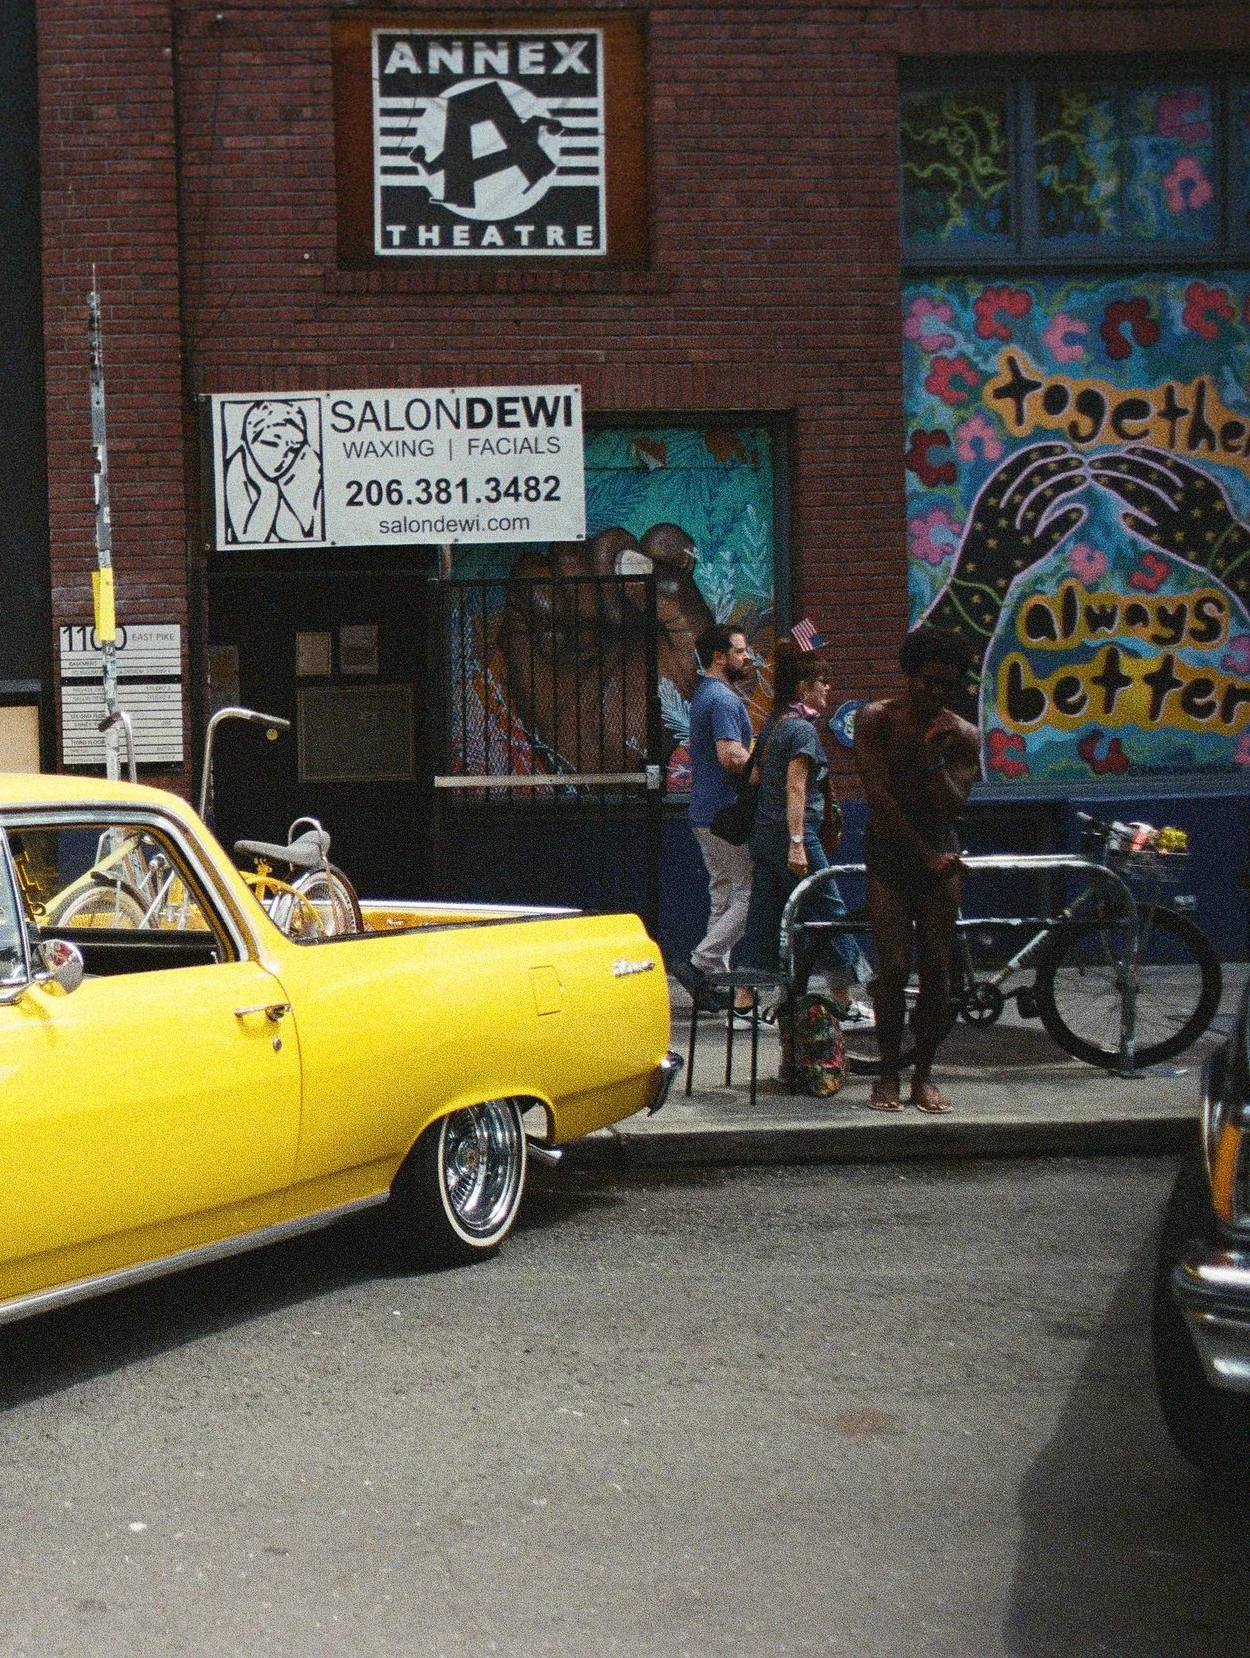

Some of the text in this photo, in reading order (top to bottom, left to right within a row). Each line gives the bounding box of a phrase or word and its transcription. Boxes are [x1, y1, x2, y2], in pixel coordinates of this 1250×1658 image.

[383, 41, 591, 75] ANNEX
[386, 224, 595, 247] THEATRE
[330, 395, 573, 433] SALONDEWI
[992, 355, 1250, 453] togethe
[342, 436, 561, 459] WAXING FACIALS
[345, 475, 562, 507] 206.381.3482
[378, 514, 531, 535] salondewi.com
[1025, 585, 1226, 646] always
[132, 633, 153, 641] EAST
[156, 632, 175, 641] PIKE
[1007, 647, 1250, 725] better
